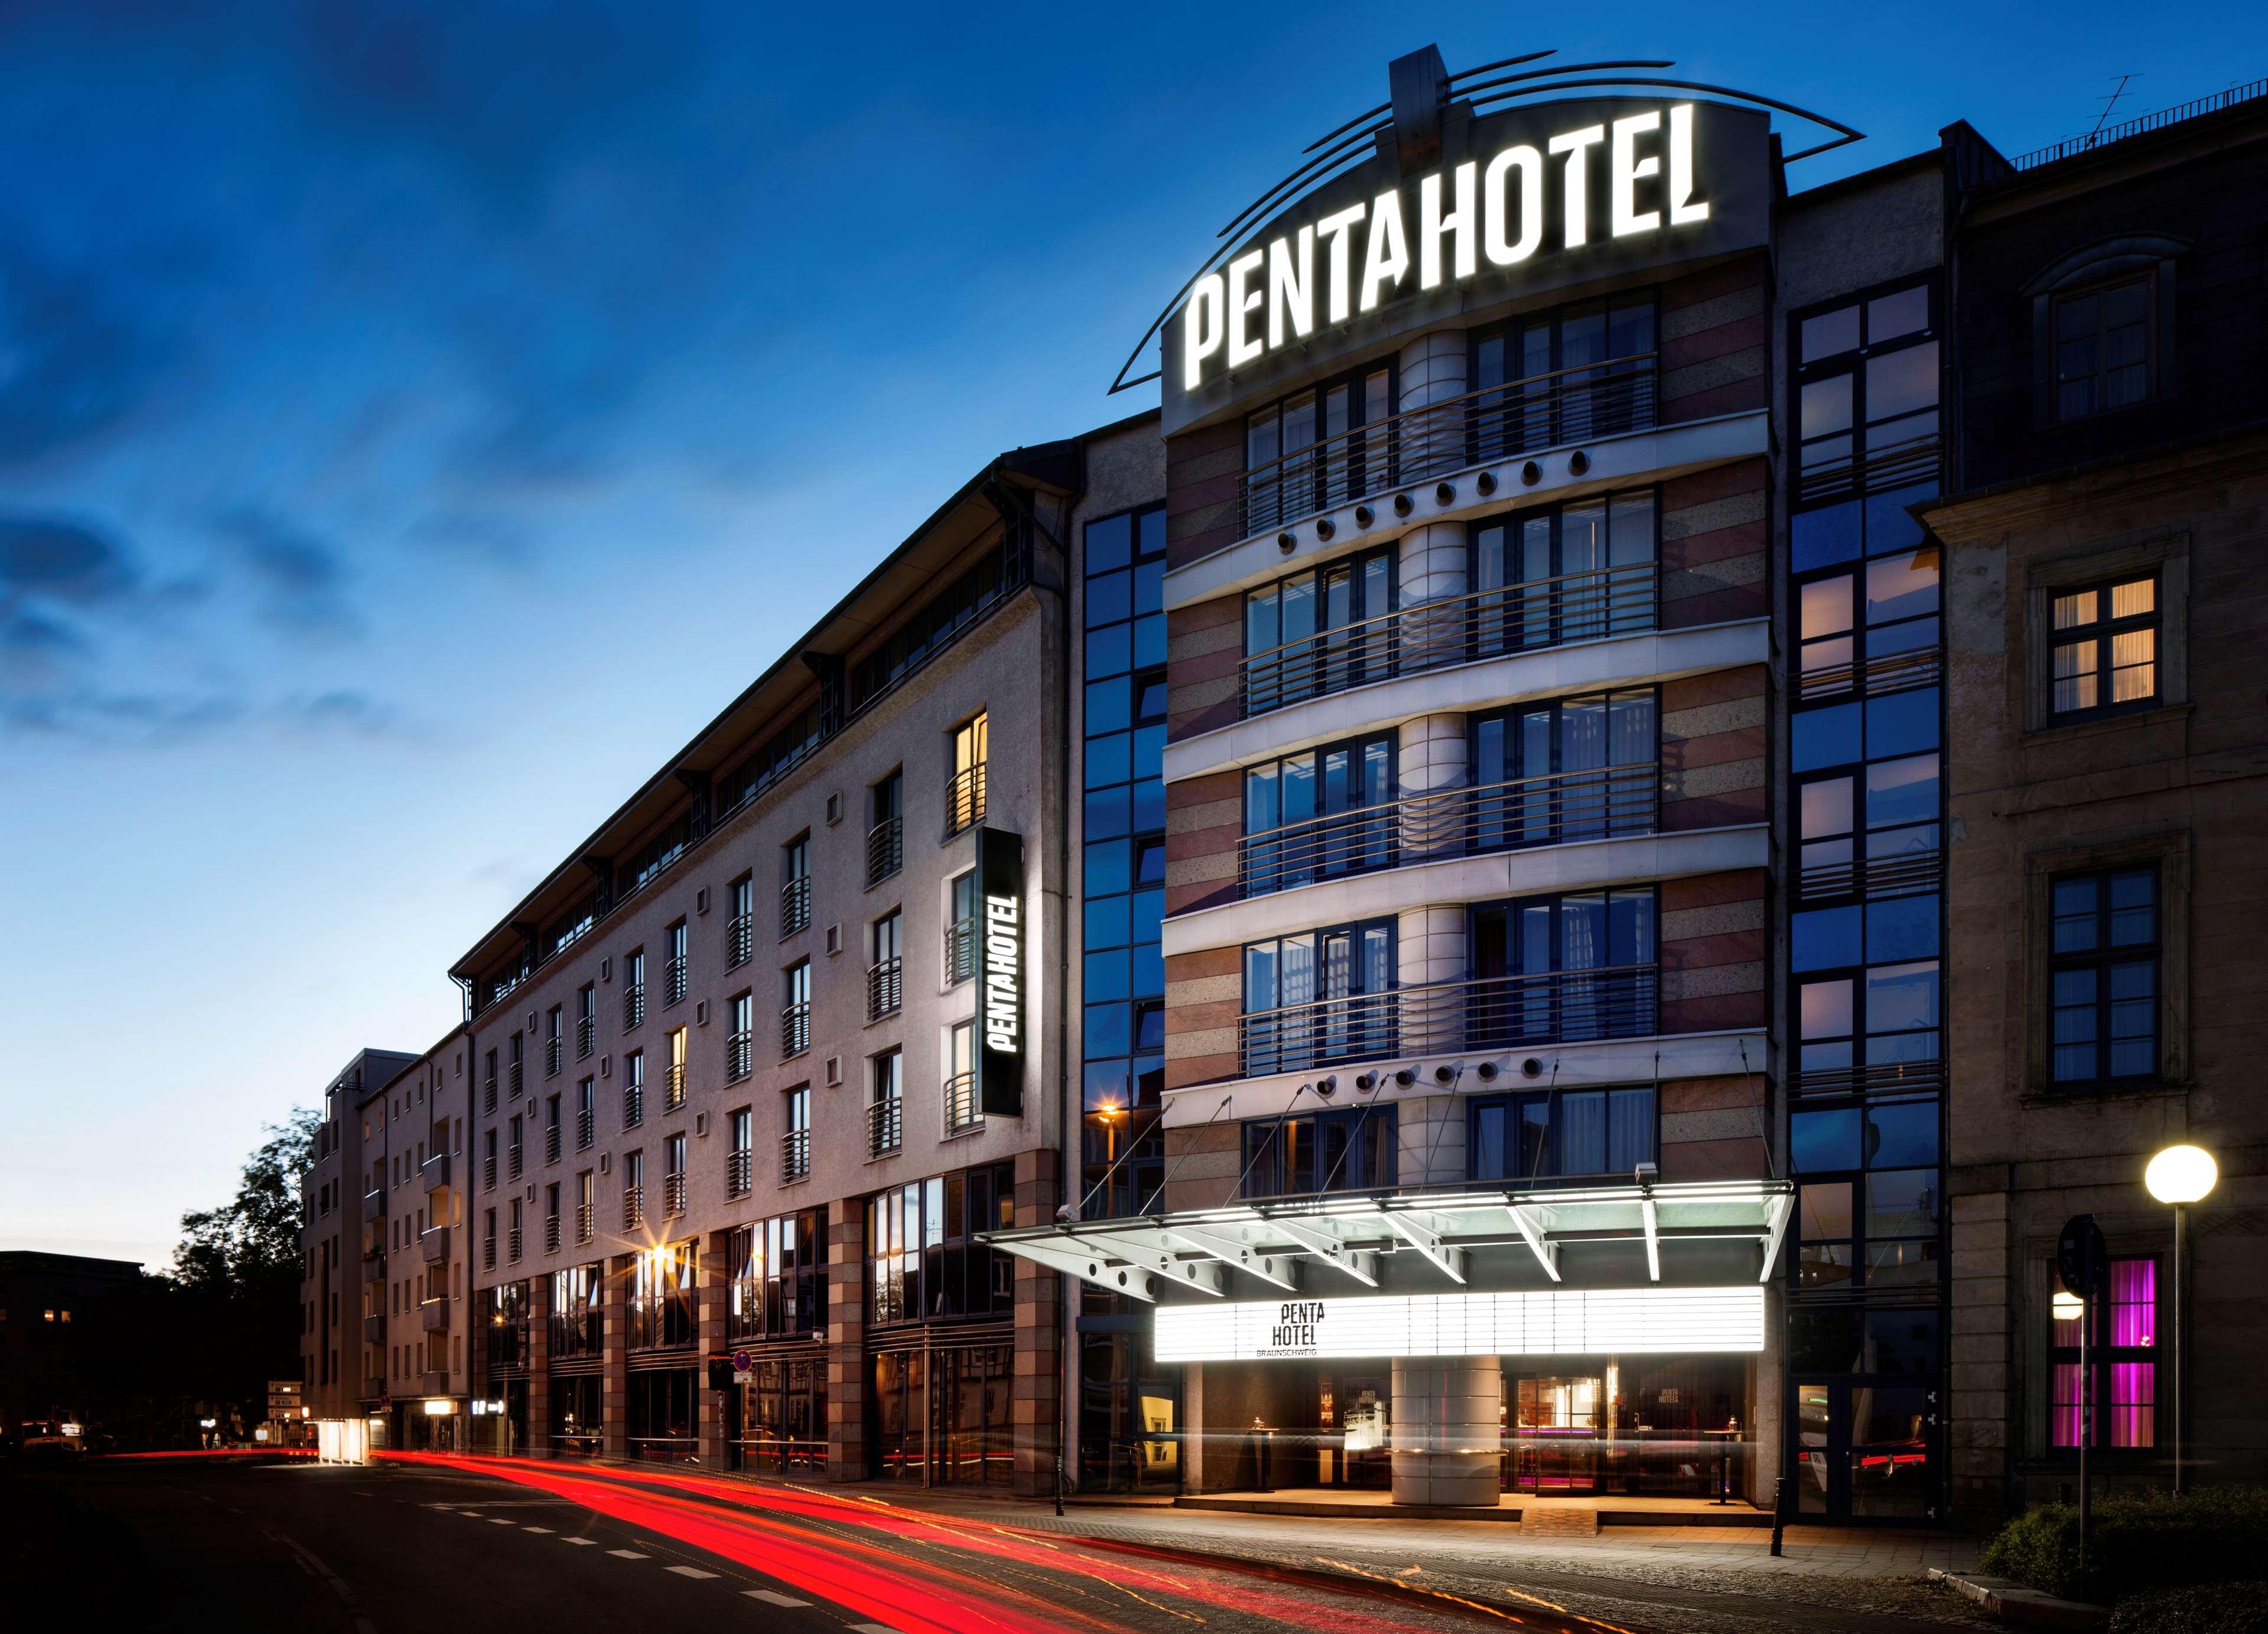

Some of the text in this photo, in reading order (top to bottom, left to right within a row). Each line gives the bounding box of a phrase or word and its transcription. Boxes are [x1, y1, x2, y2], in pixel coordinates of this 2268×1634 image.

[1185, 104, 1709, 390] PENTAHOTEL
[987, 896, 1017, 1053] PENTAHOTEL
[1281, 1302, 1325, 1324] PENTA
[1273, 1324, 1316, 1346] HOTEL
[1257, 1349, 1317, 1357] BRAUNSCHWEIG
